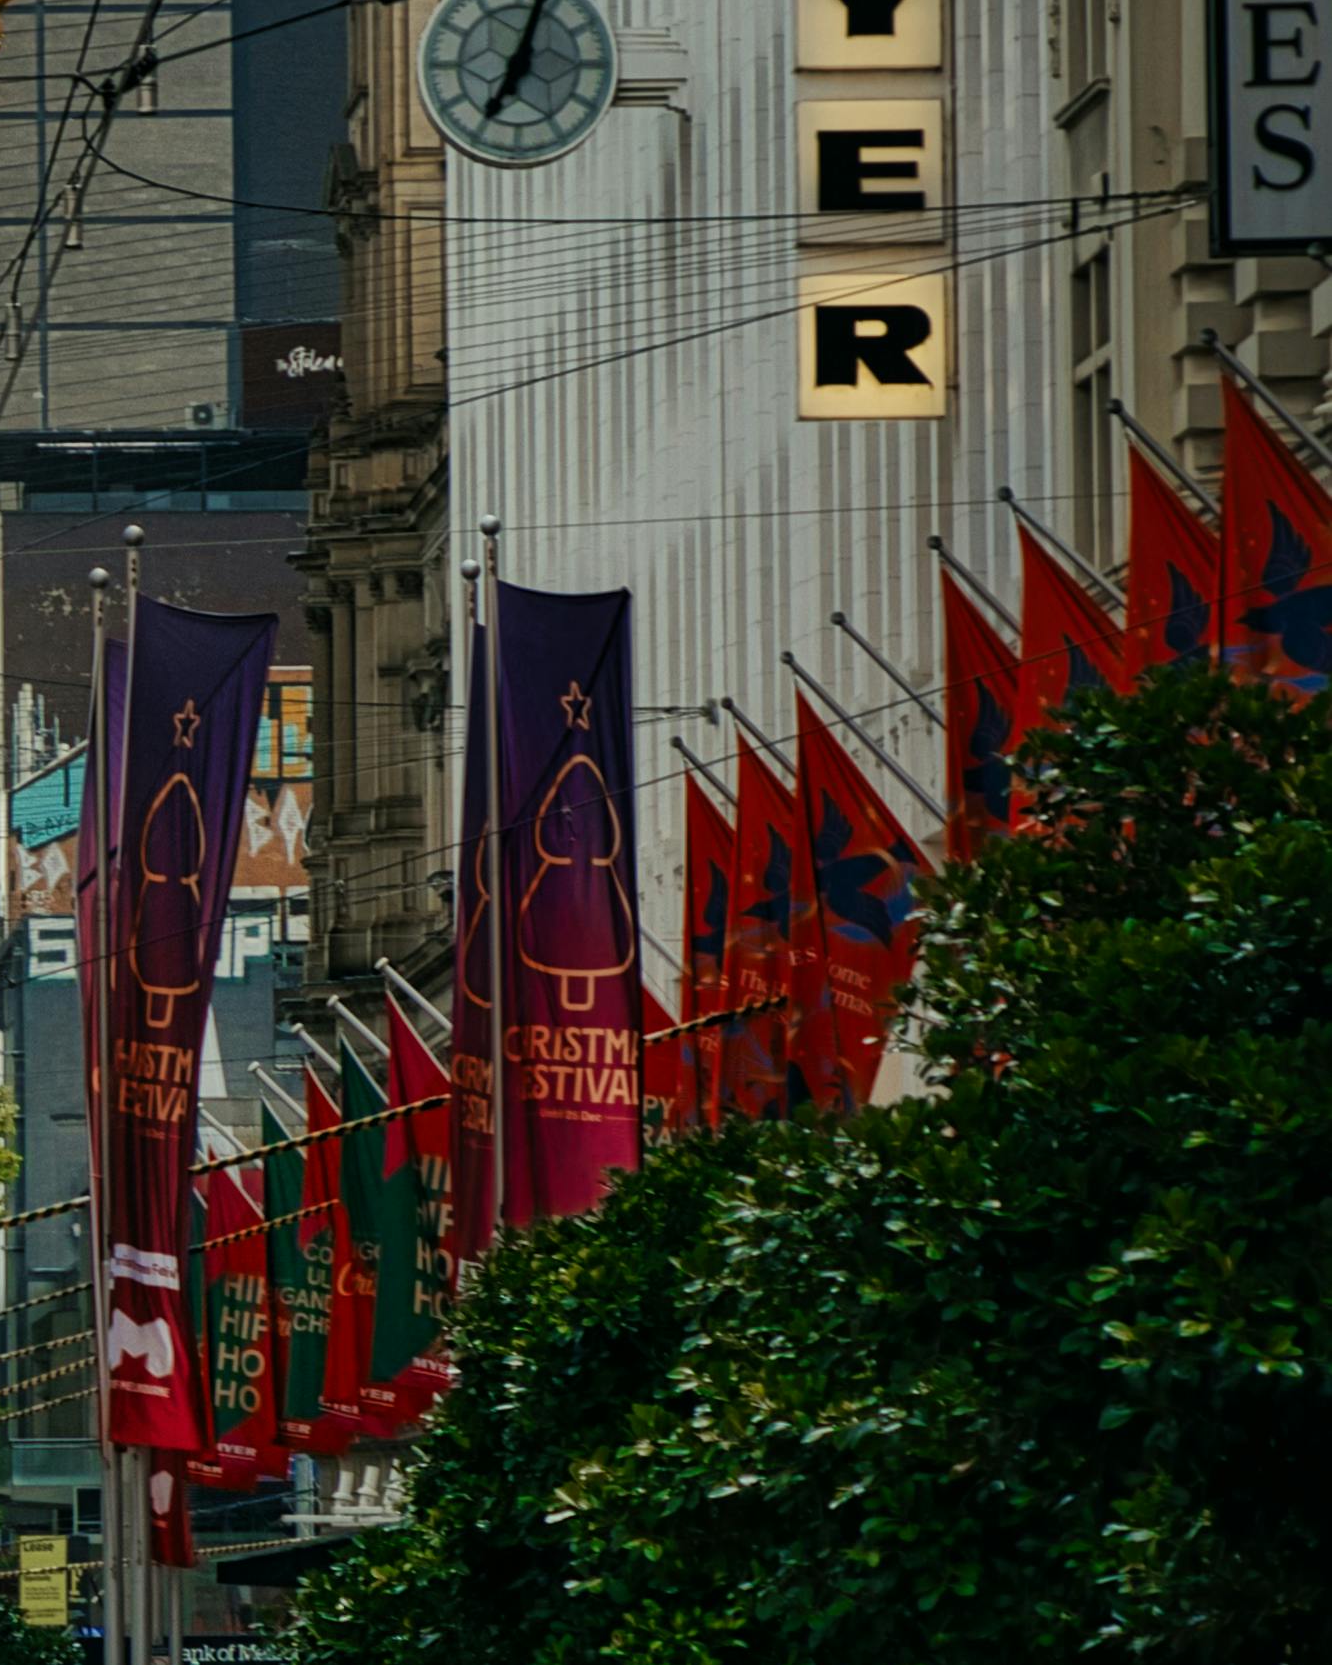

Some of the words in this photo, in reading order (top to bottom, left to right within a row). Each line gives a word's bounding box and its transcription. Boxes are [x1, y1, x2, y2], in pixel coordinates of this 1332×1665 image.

[217, 1341, 265, 1378] HO
[213, 1378, 262, 1413] HO
[23, 1541, 54, 1553] Lease
[182, 1644, 216, 1663] ank
[216, 1643, 236, 1663] of
